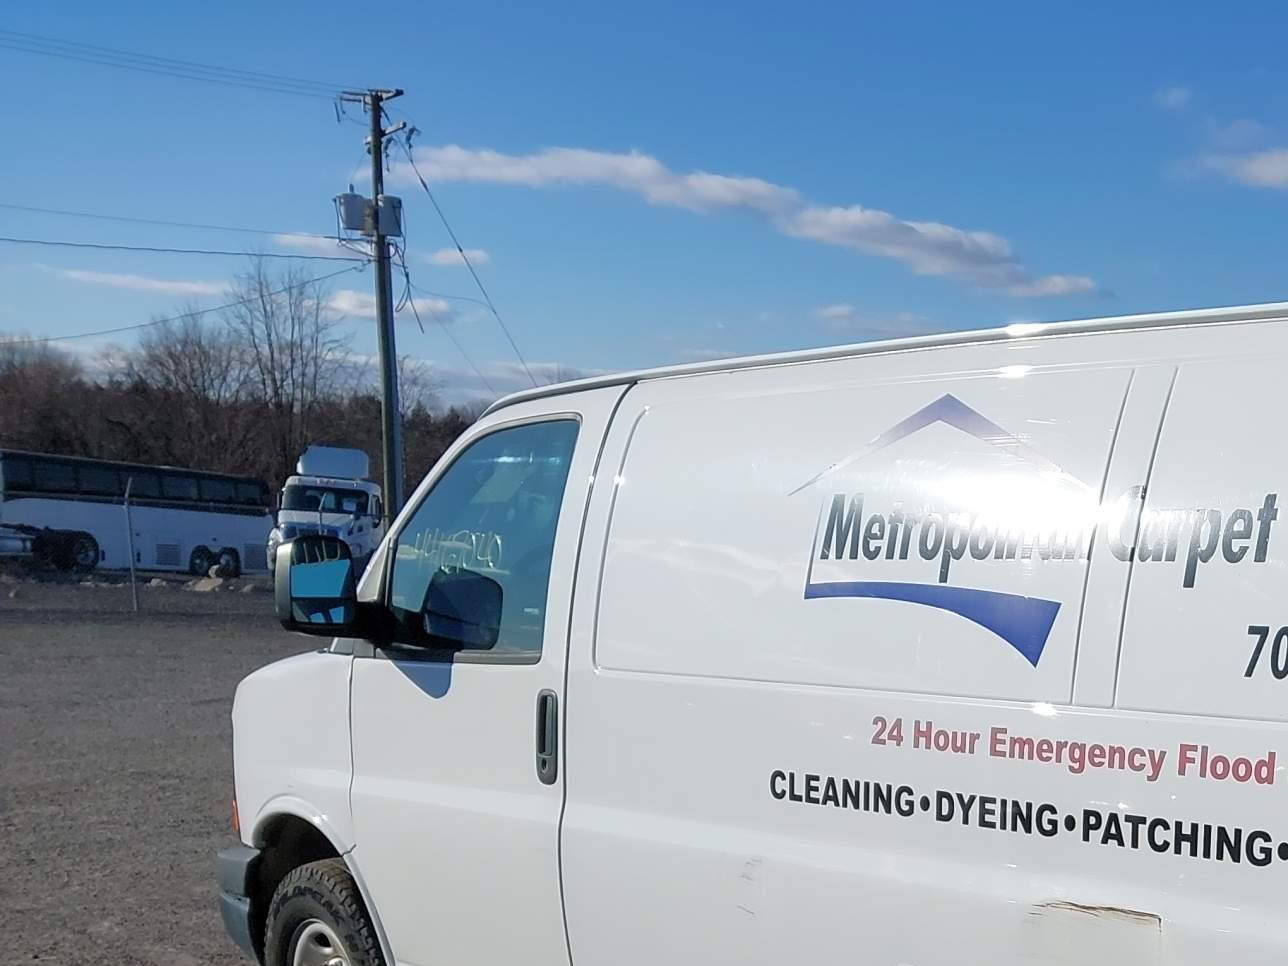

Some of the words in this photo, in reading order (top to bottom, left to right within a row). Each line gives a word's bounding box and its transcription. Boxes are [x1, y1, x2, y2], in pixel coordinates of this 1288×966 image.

[1107, 485, 1277, 588] Carpet
[871, 716, 903, 747] 24
[913, 720, 980, 755] Hour
[989, 727, 1167, 782] Emergency
[1177, 744, 1276, 785] Flood
